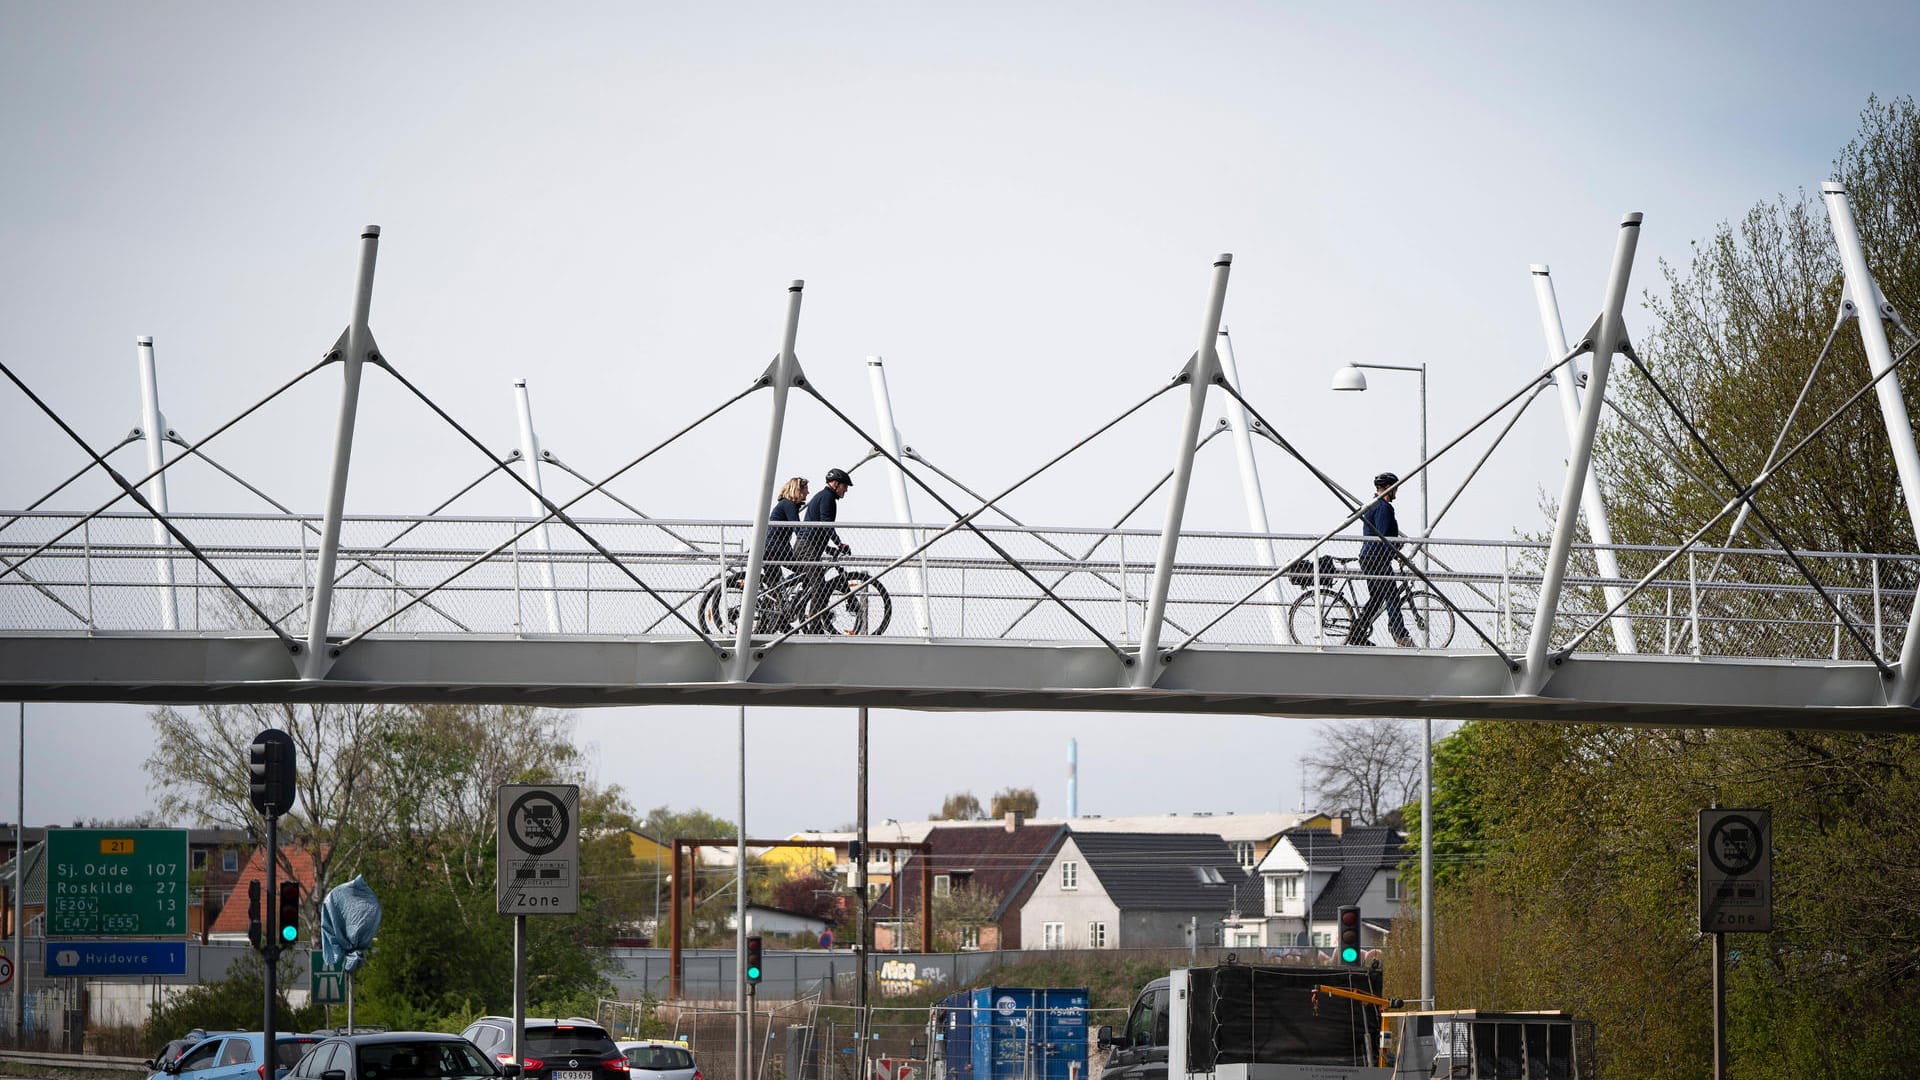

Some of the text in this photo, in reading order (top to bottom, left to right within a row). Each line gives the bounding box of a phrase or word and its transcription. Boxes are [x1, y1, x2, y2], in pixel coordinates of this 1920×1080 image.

[111, 841, 125, 852] 21
[57, 863, 177, 878] Sj. Odde 107
[57, 881, 177, 894] Roskilde 27
[156, 899, 176, 911] 13
[517, 893, 560, 907] Zone
[63, 916, 176, 929] E47 E55 4
[1717, 911, 1756, 925] Zone
[86, 952, 150, 964] Hvidovre
[169, 952, 175, 963] 1
[0, 964, 10, 976] 0
[569, 1071, 577, 1079] 93
[578, 1071, 592, 1079] 675
